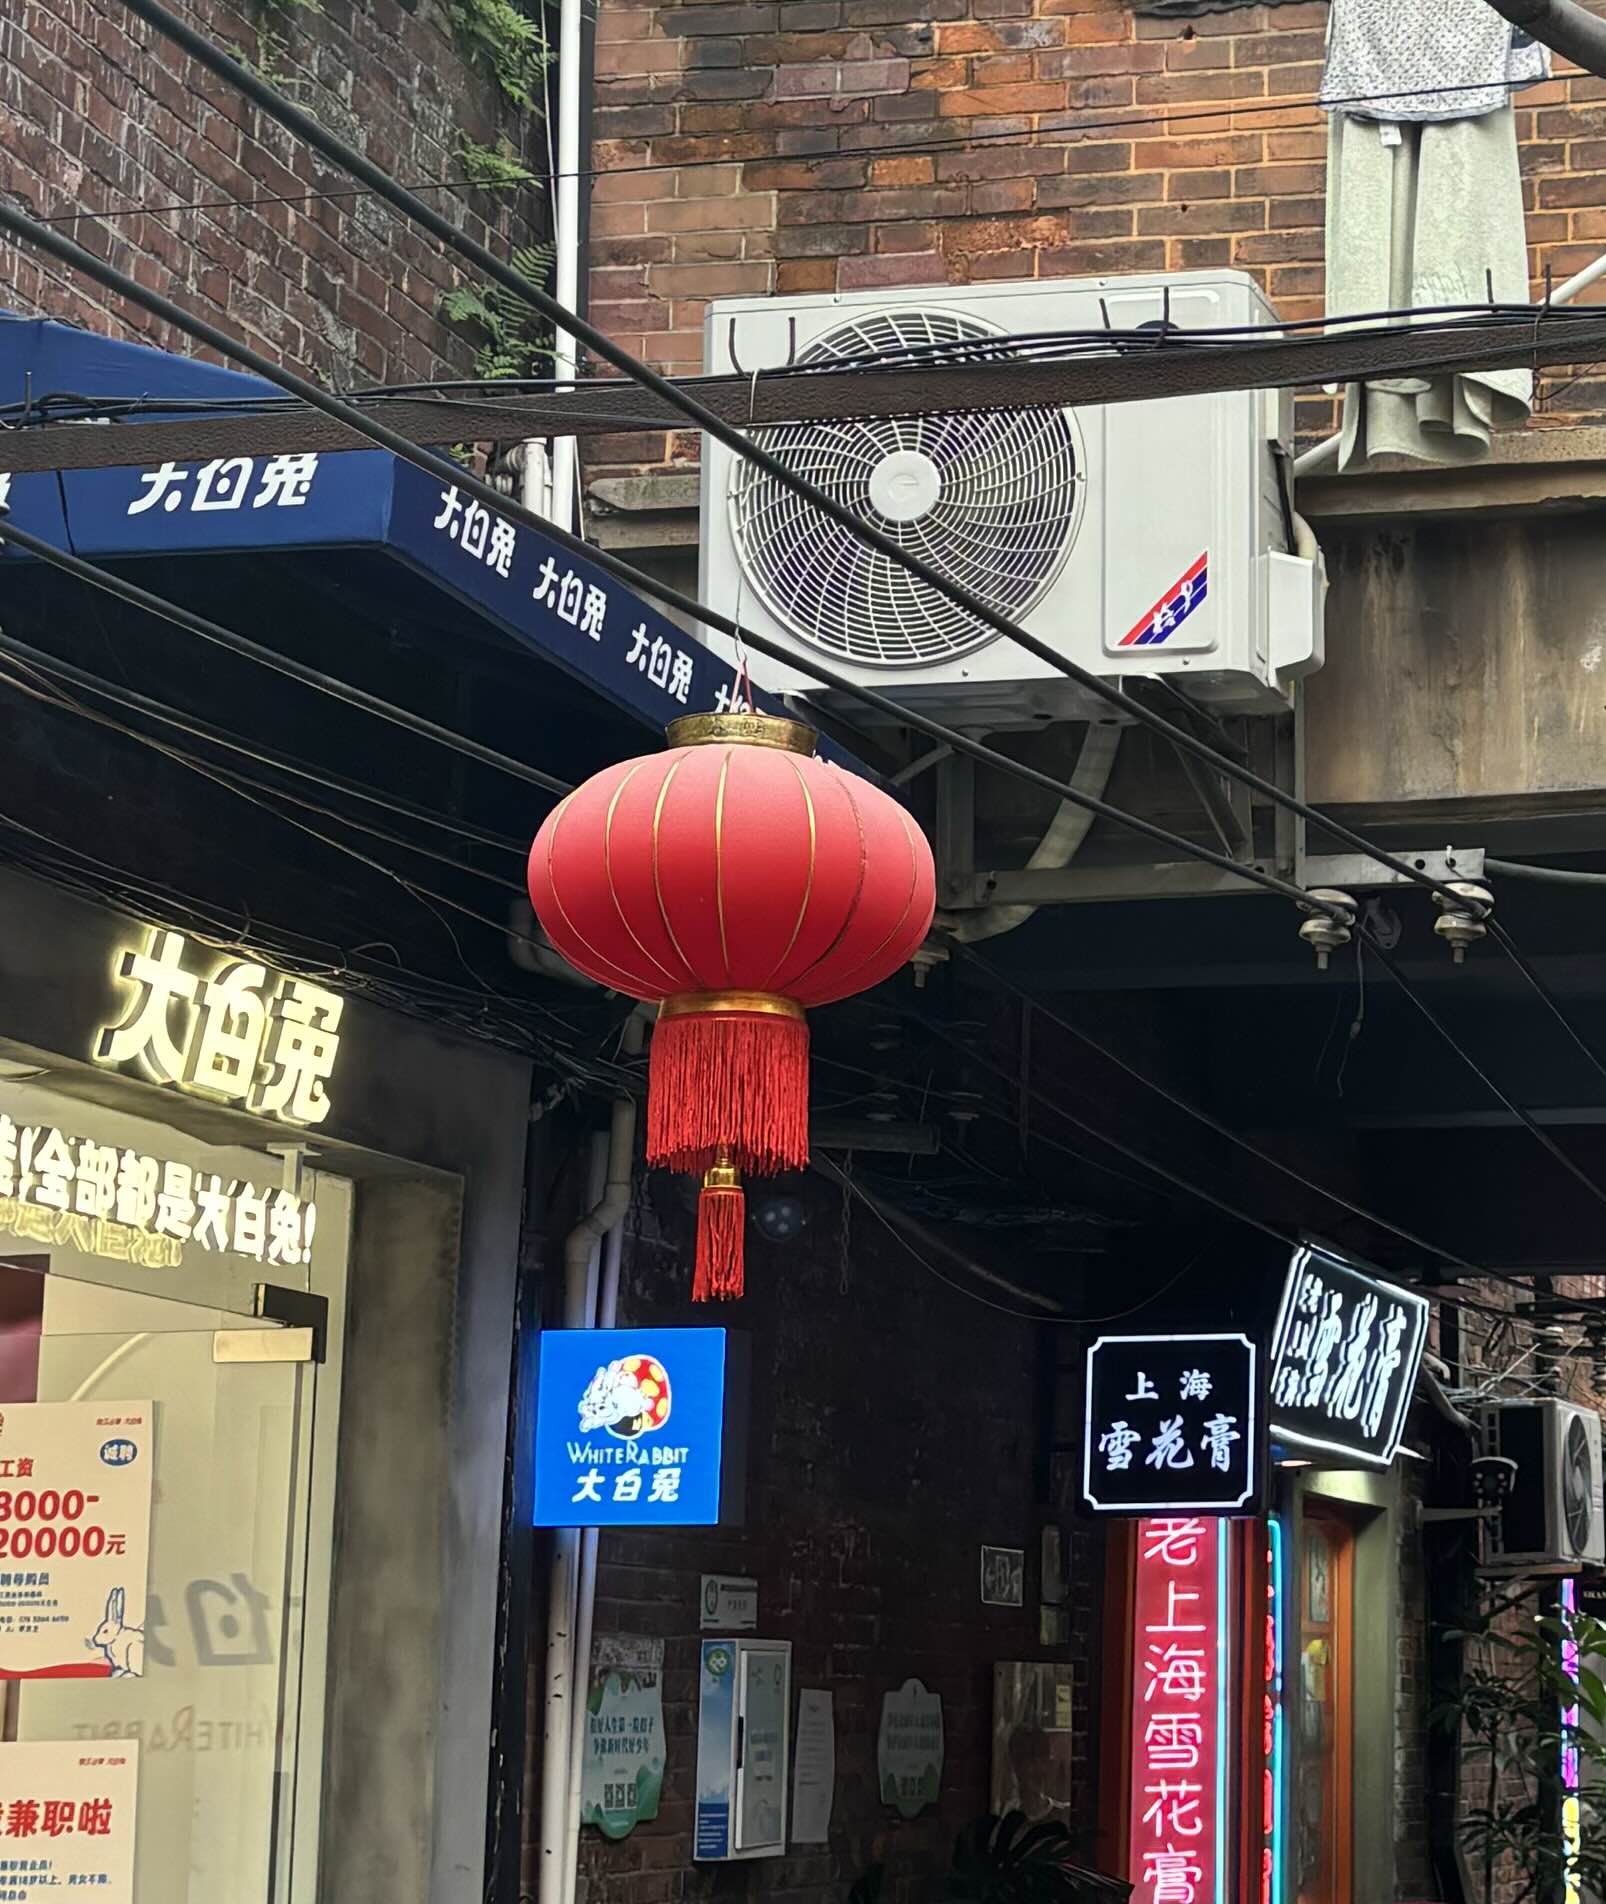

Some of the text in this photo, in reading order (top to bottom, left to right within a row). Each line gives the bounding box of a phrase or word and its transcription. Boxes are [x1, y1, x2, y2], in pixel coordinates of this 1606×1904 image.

[127, 452, 319, 515] 大白兔
[433, 484, 517, 579] 大白兔
[532, 556, 608, 642] 大白兔
[625, 622, 695, 705] 大白兔
[96, 930, 345, 1124] 大白兔
[1125, 1369, 1214, 1401] 上海
[1098, 1413, 1241, 1472] 雪花膏
[571, 1468, 682, 1503] 大白兔
[0, 1798, 113, 1838] 兼职啦
